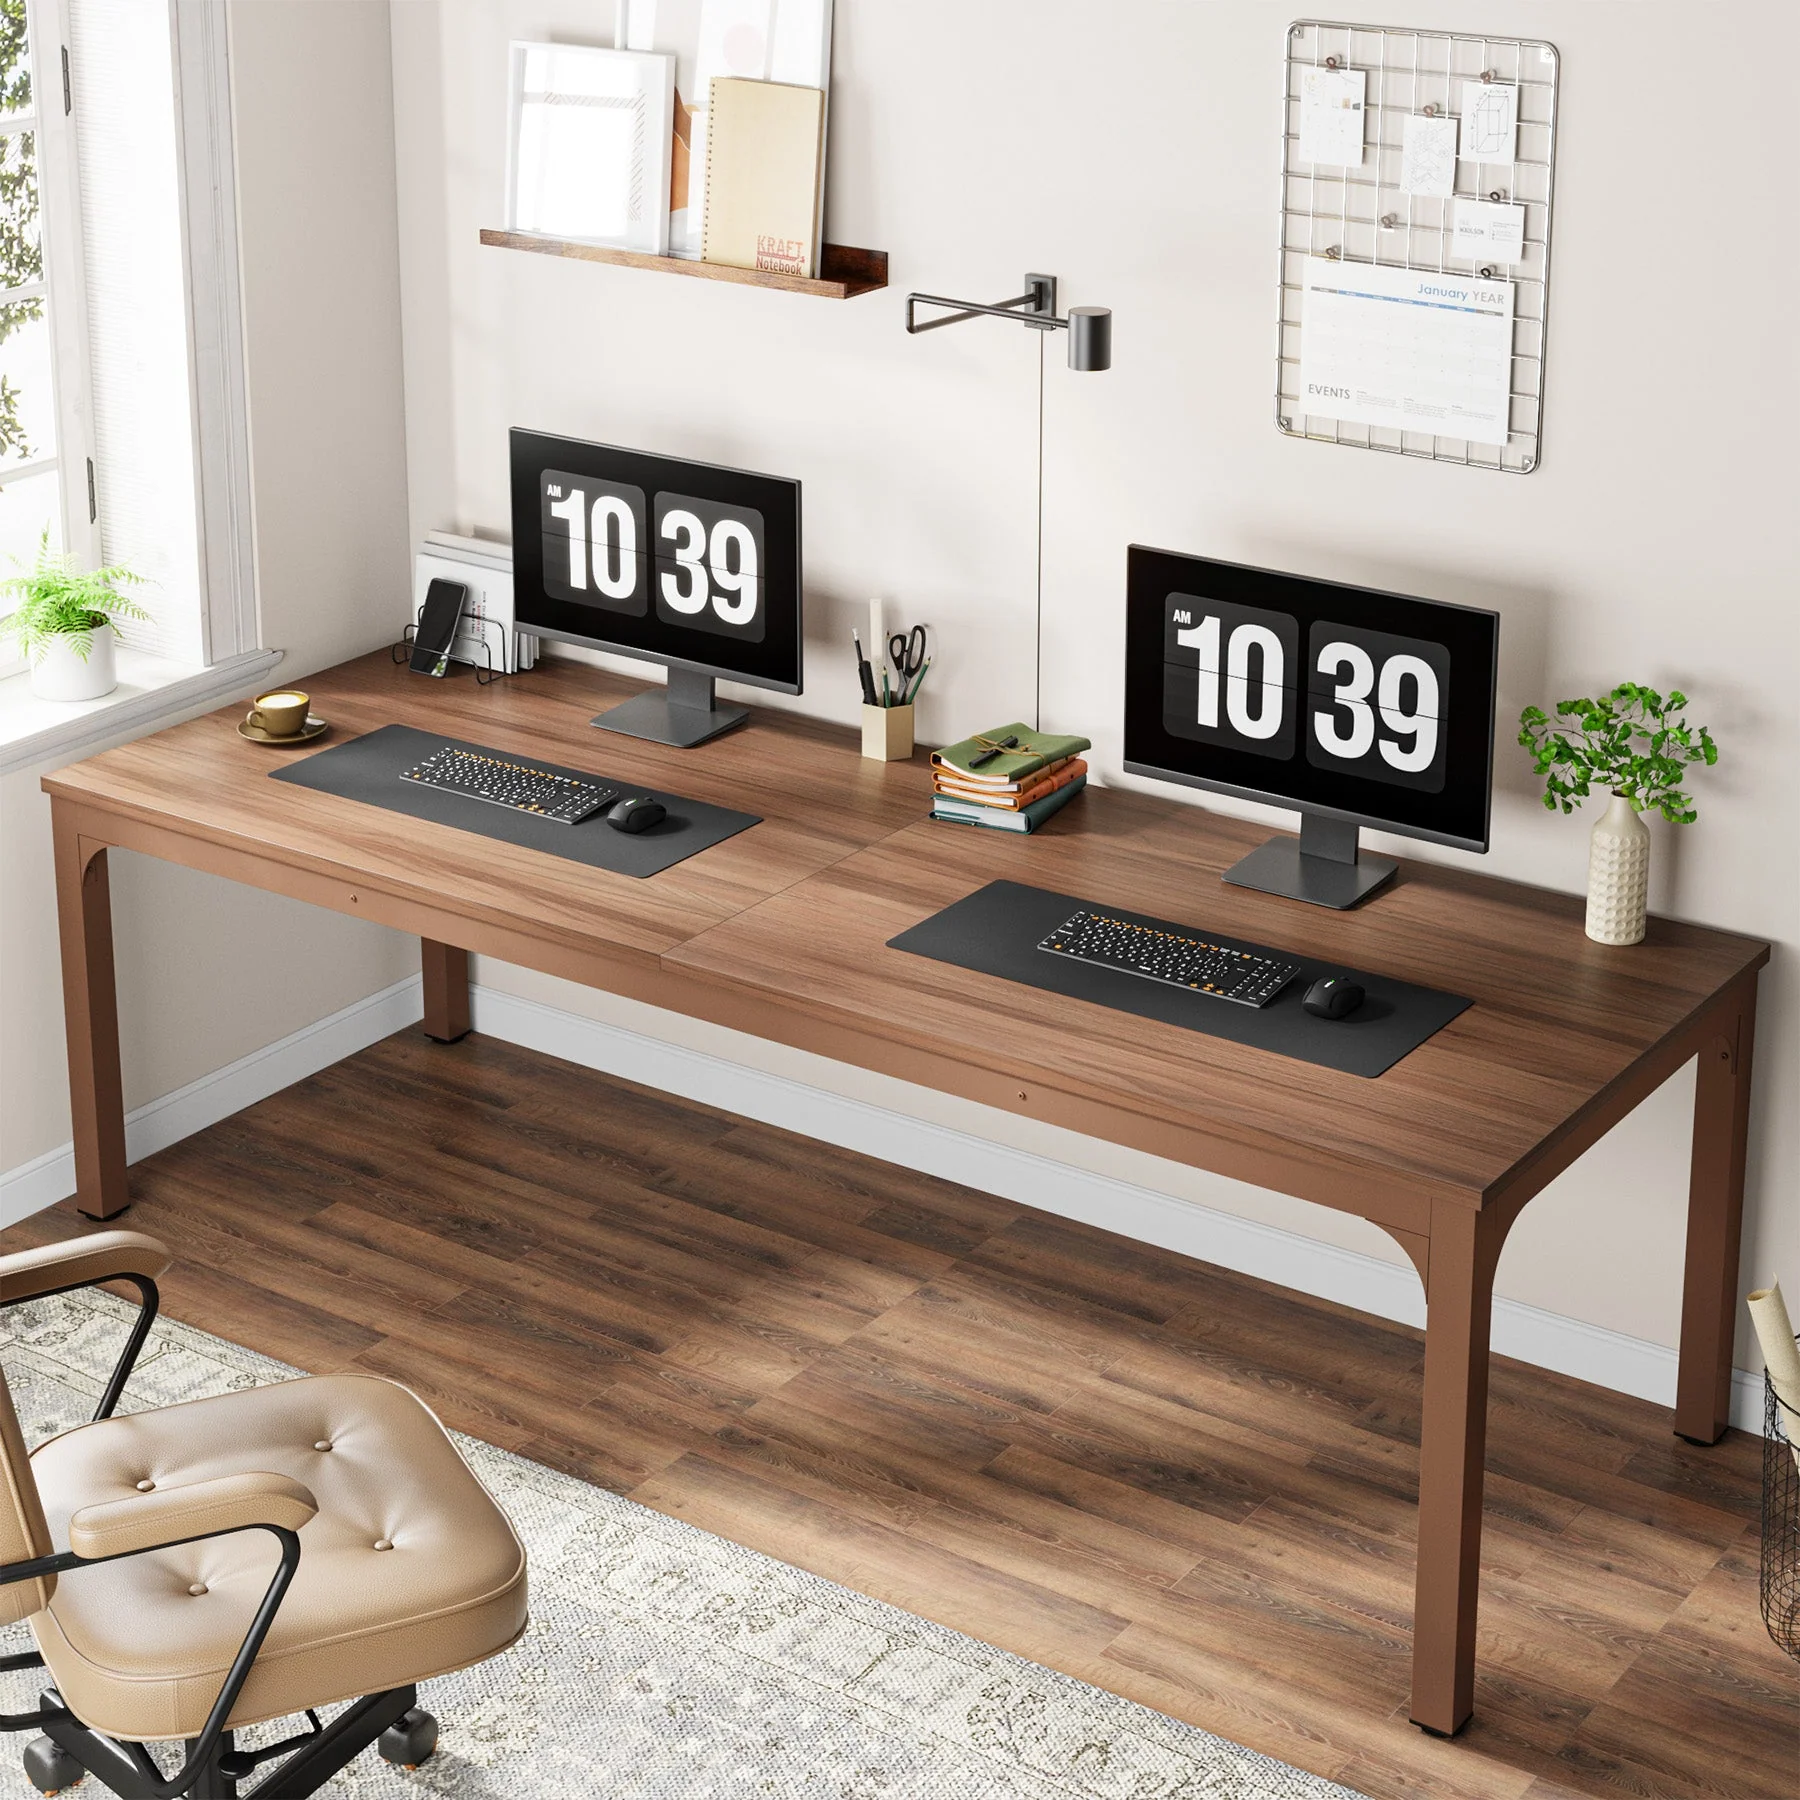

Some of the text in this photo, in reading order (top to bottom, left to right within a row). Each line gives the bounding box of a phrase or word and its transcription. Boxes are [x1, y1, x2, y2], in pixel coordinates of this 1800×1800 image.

[757, 234, 803, 259] KRAFT
[756, 256, 802, 275] Notebook
[1417, 283, 1505, 305] January YEAR
[1308, 383, 1351, 400] EVENTS
[547, 484, 562, 498] AM
[551, 489, 758, 626] 10 39
[1173, 608, 1192, 625] AM
[1177, 615, 1440, 774] 10 39
